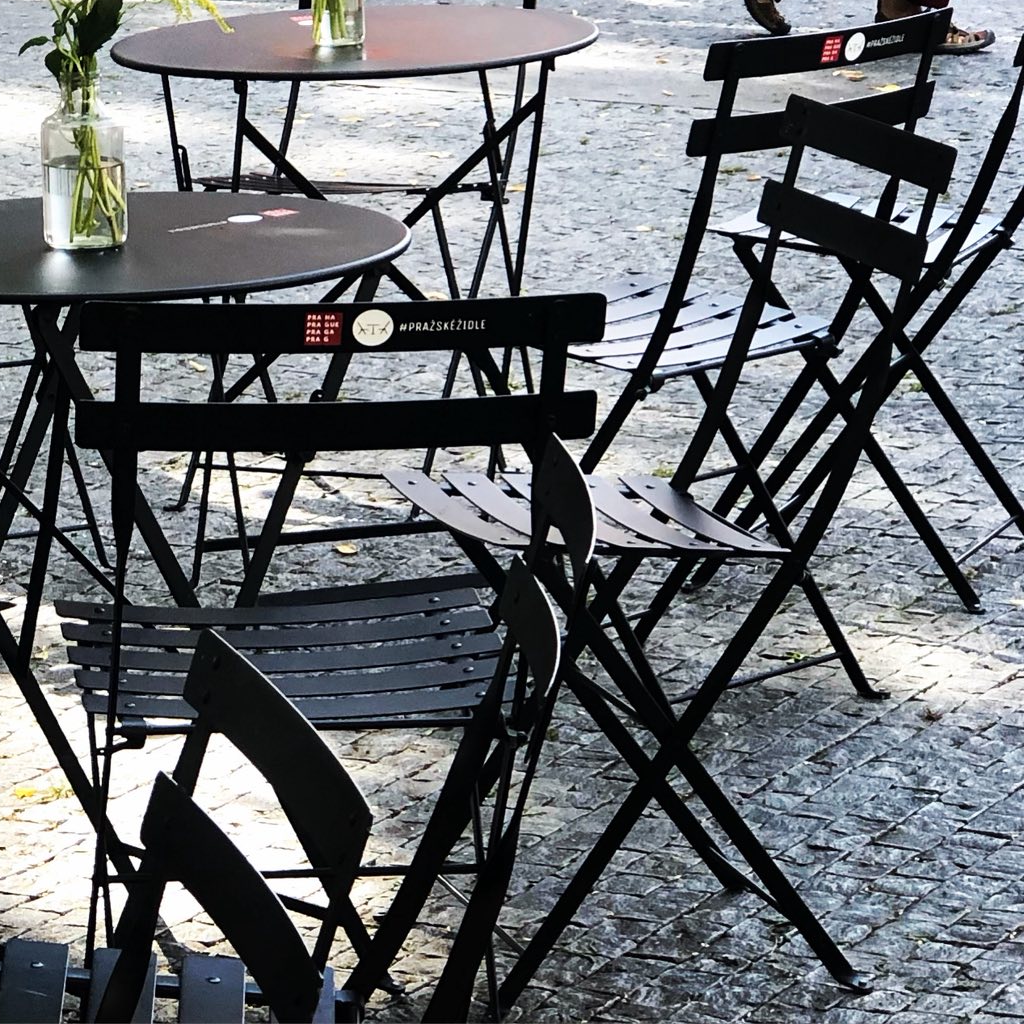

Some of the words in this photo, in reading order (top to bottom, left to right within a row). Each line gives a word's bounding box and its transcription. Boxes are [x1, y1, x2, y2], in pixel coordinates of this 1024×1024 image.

[399, 319, 487, 332] #PRAŽSKÉŽIDLE
[306, 328, 321, 336] PRA
[323, 328, 335, 336] GA
